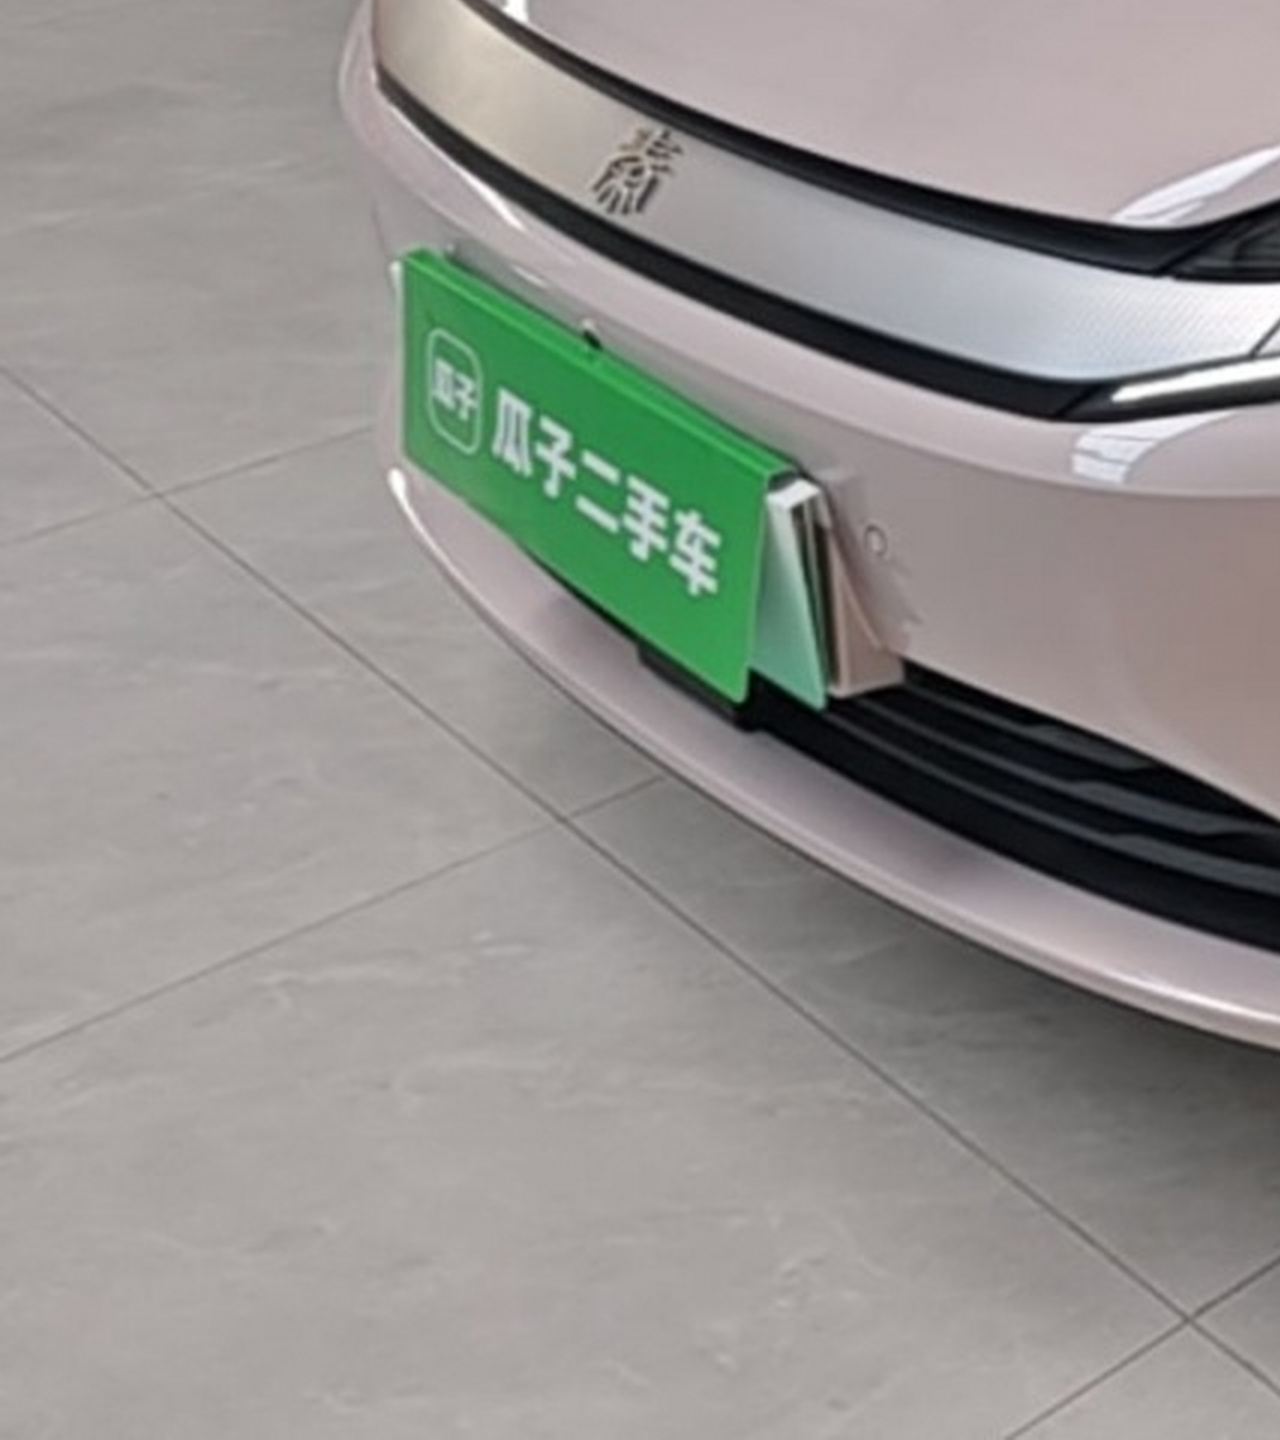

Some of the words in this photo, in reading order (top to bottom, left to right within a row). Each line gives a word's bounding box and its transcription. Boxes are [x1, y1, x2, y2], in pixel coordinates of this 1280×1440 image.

[432, 356, 478, 421] 瓜子
[491, 387, 722, 597] 瓜子二手车
